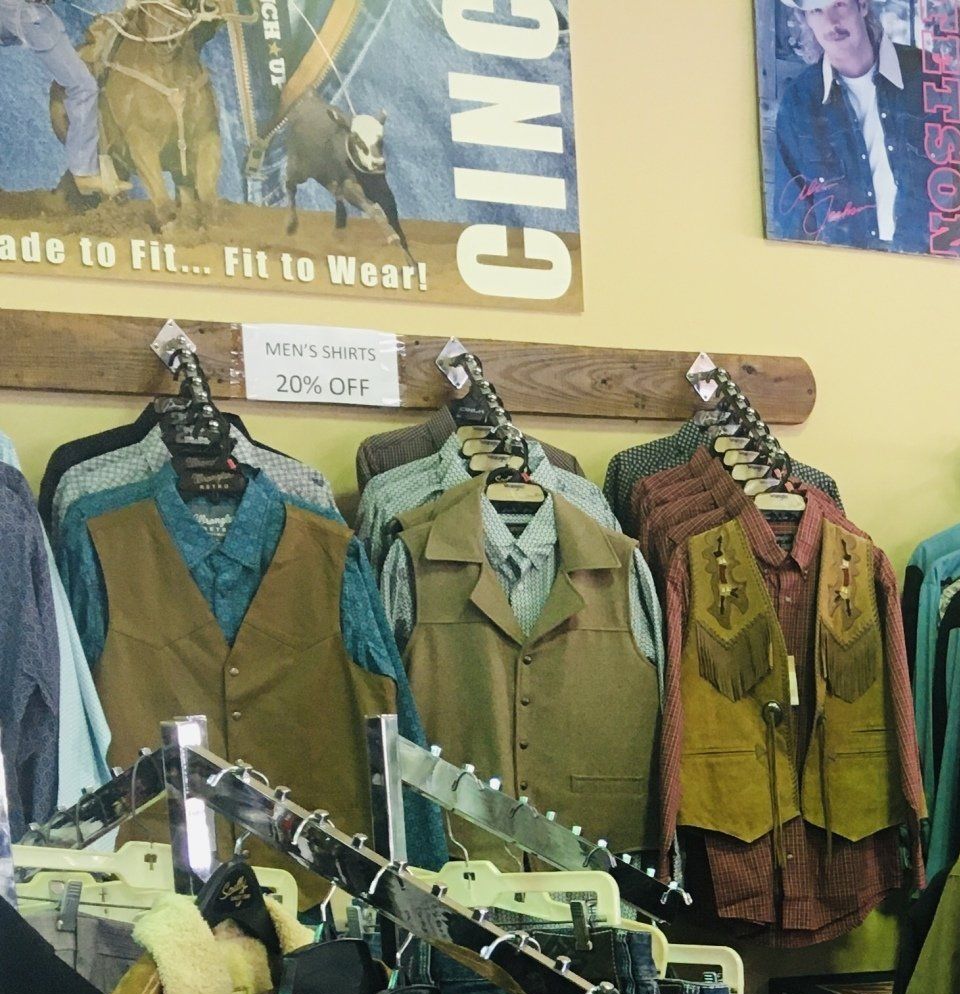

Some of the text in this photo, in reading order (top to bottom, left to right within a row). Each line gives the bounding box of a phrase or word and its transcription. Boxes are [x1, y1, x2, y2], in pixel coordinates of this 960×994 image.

[260, 0, 281, 40] CH
[442, 0, 572, 300] CINC
[80, 237, 115, 268] to
[130, 239, 211, 275] Fit...
[224, 246, 270, 279] Fit
[281, 251, 315, 283] to
[326, 254, 428, 291] Wear!
[265, 342, 376, 361] MEN'S SHIRTS
[276, 374, 370, 396] 20% OFF
